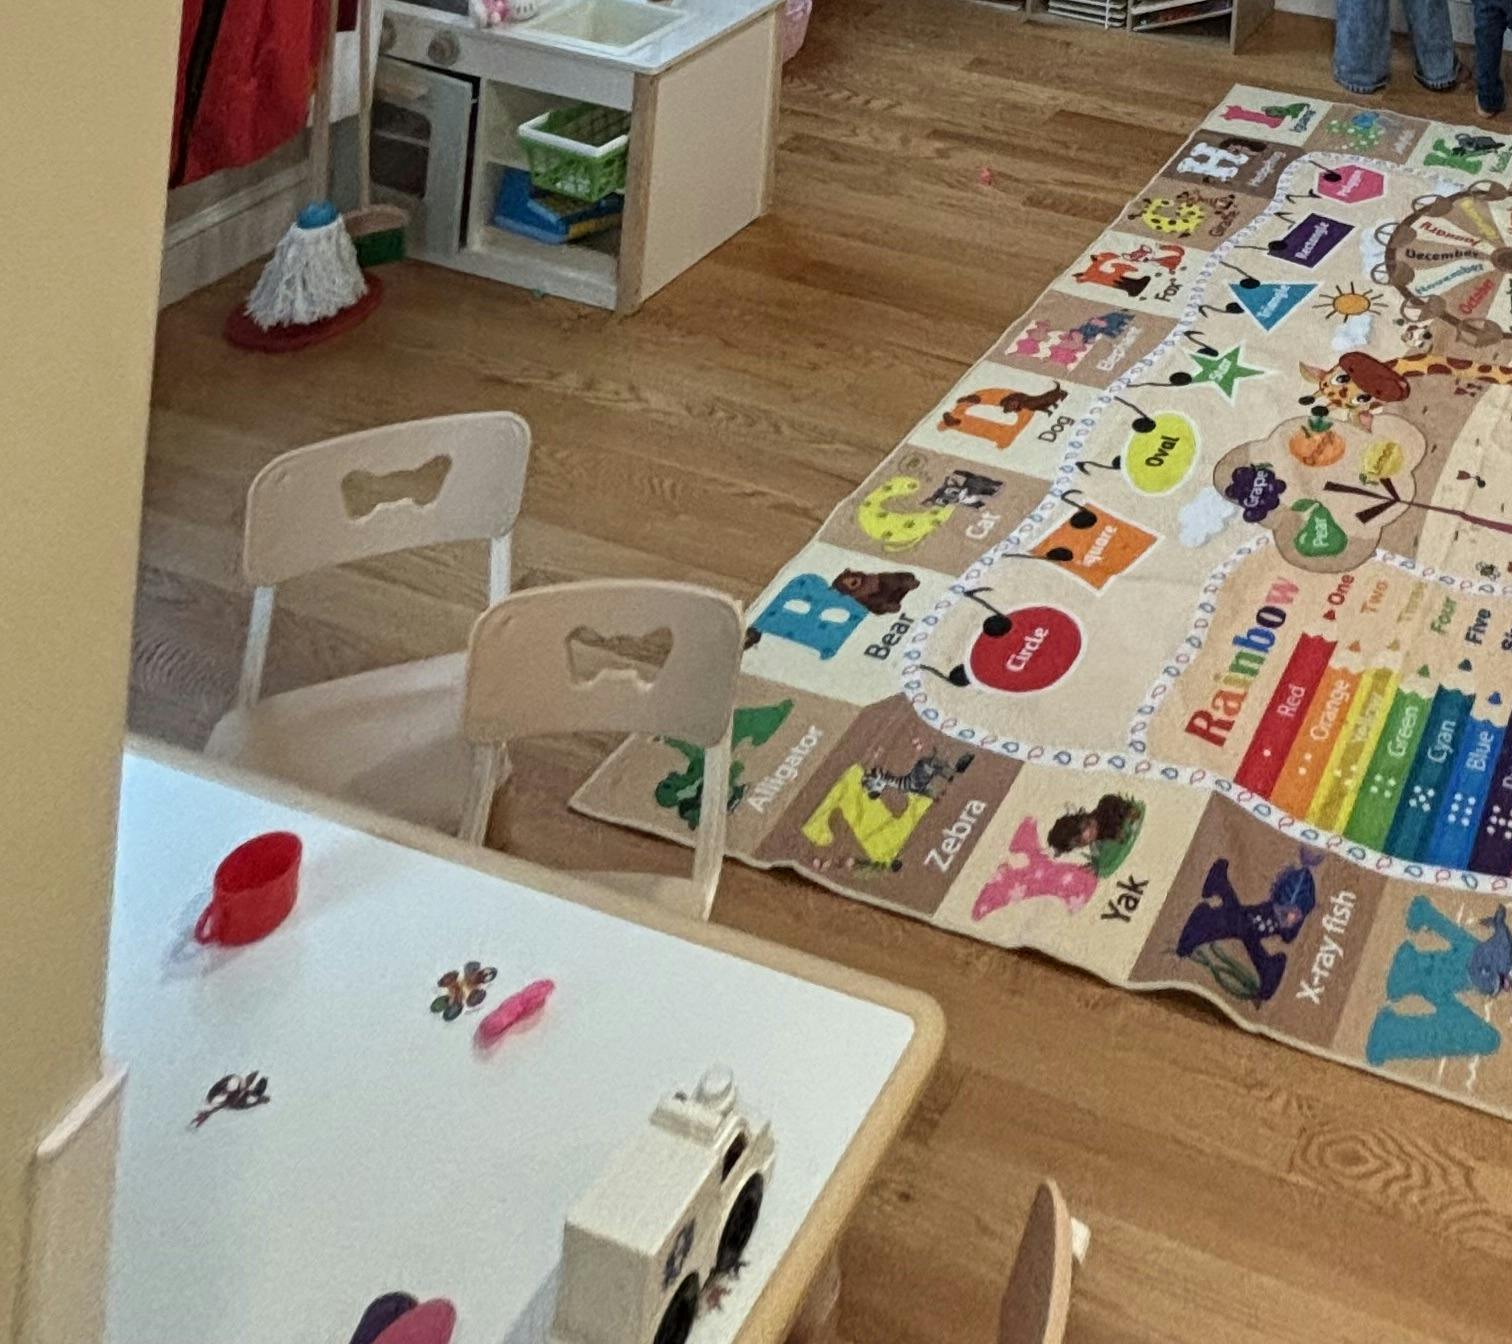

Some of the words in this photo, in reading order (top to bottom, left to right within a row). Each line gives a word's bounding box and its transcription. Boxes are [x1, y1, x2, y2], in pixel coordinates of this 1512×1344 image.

[1176, 141, 1250, 182] H
[1294, 220, 1330, 261] Rectangle
[1404, 247, 1480, 262] December
[1419, 220, 1482, 248] January
[1154, 278, 1184, 303] Fox
[1414, 262, 1484, 296] November
[936, 387, 1036, 451] D
[1037, 413, 1076, 444] Dog
[1144, 435, 1181, 468] Oval
[1242, 468, 1269, 508] Grape
[857, 475, 956, 553] C
[964, 511, 1000, 540] Cat
[1312, 516, 1330, 548] Pear
[1327, 574, 1355, 606] One
[1360, 579, 1389, 614] Two
[750, 572, 870, 661] B
[863, 612, 917, 662] Bear
[1430, 596, 1457, 634] Four
[1464, 608, 1492, 646] Five
[1005, 623, 1051, 672] Circle
[1184, 576, 1300, 748] Rainbow
[1277, 683, 1306, 718] Red
[1309, 679, 1351, 742] Orange
[1387, 705, 1419, 758] Green
[1427, 718, 1457, 763] Cyan
[1465, 729, 1495, 773] Blue
[746, 723, 825, 813] Alligator
[801, 762, 934, 865] Z
[924, 799, 987, 874] Zebra
[970, 816, 1100, 923] Y
[1100, 874, 1150, 925] Yak
[1177, 857, 1299, 1003] X
[1295, 934, 1345, 1005] X-ray
[1321, 890, 1357, 933] fish
[1365, 894, 1501, 1066] W
